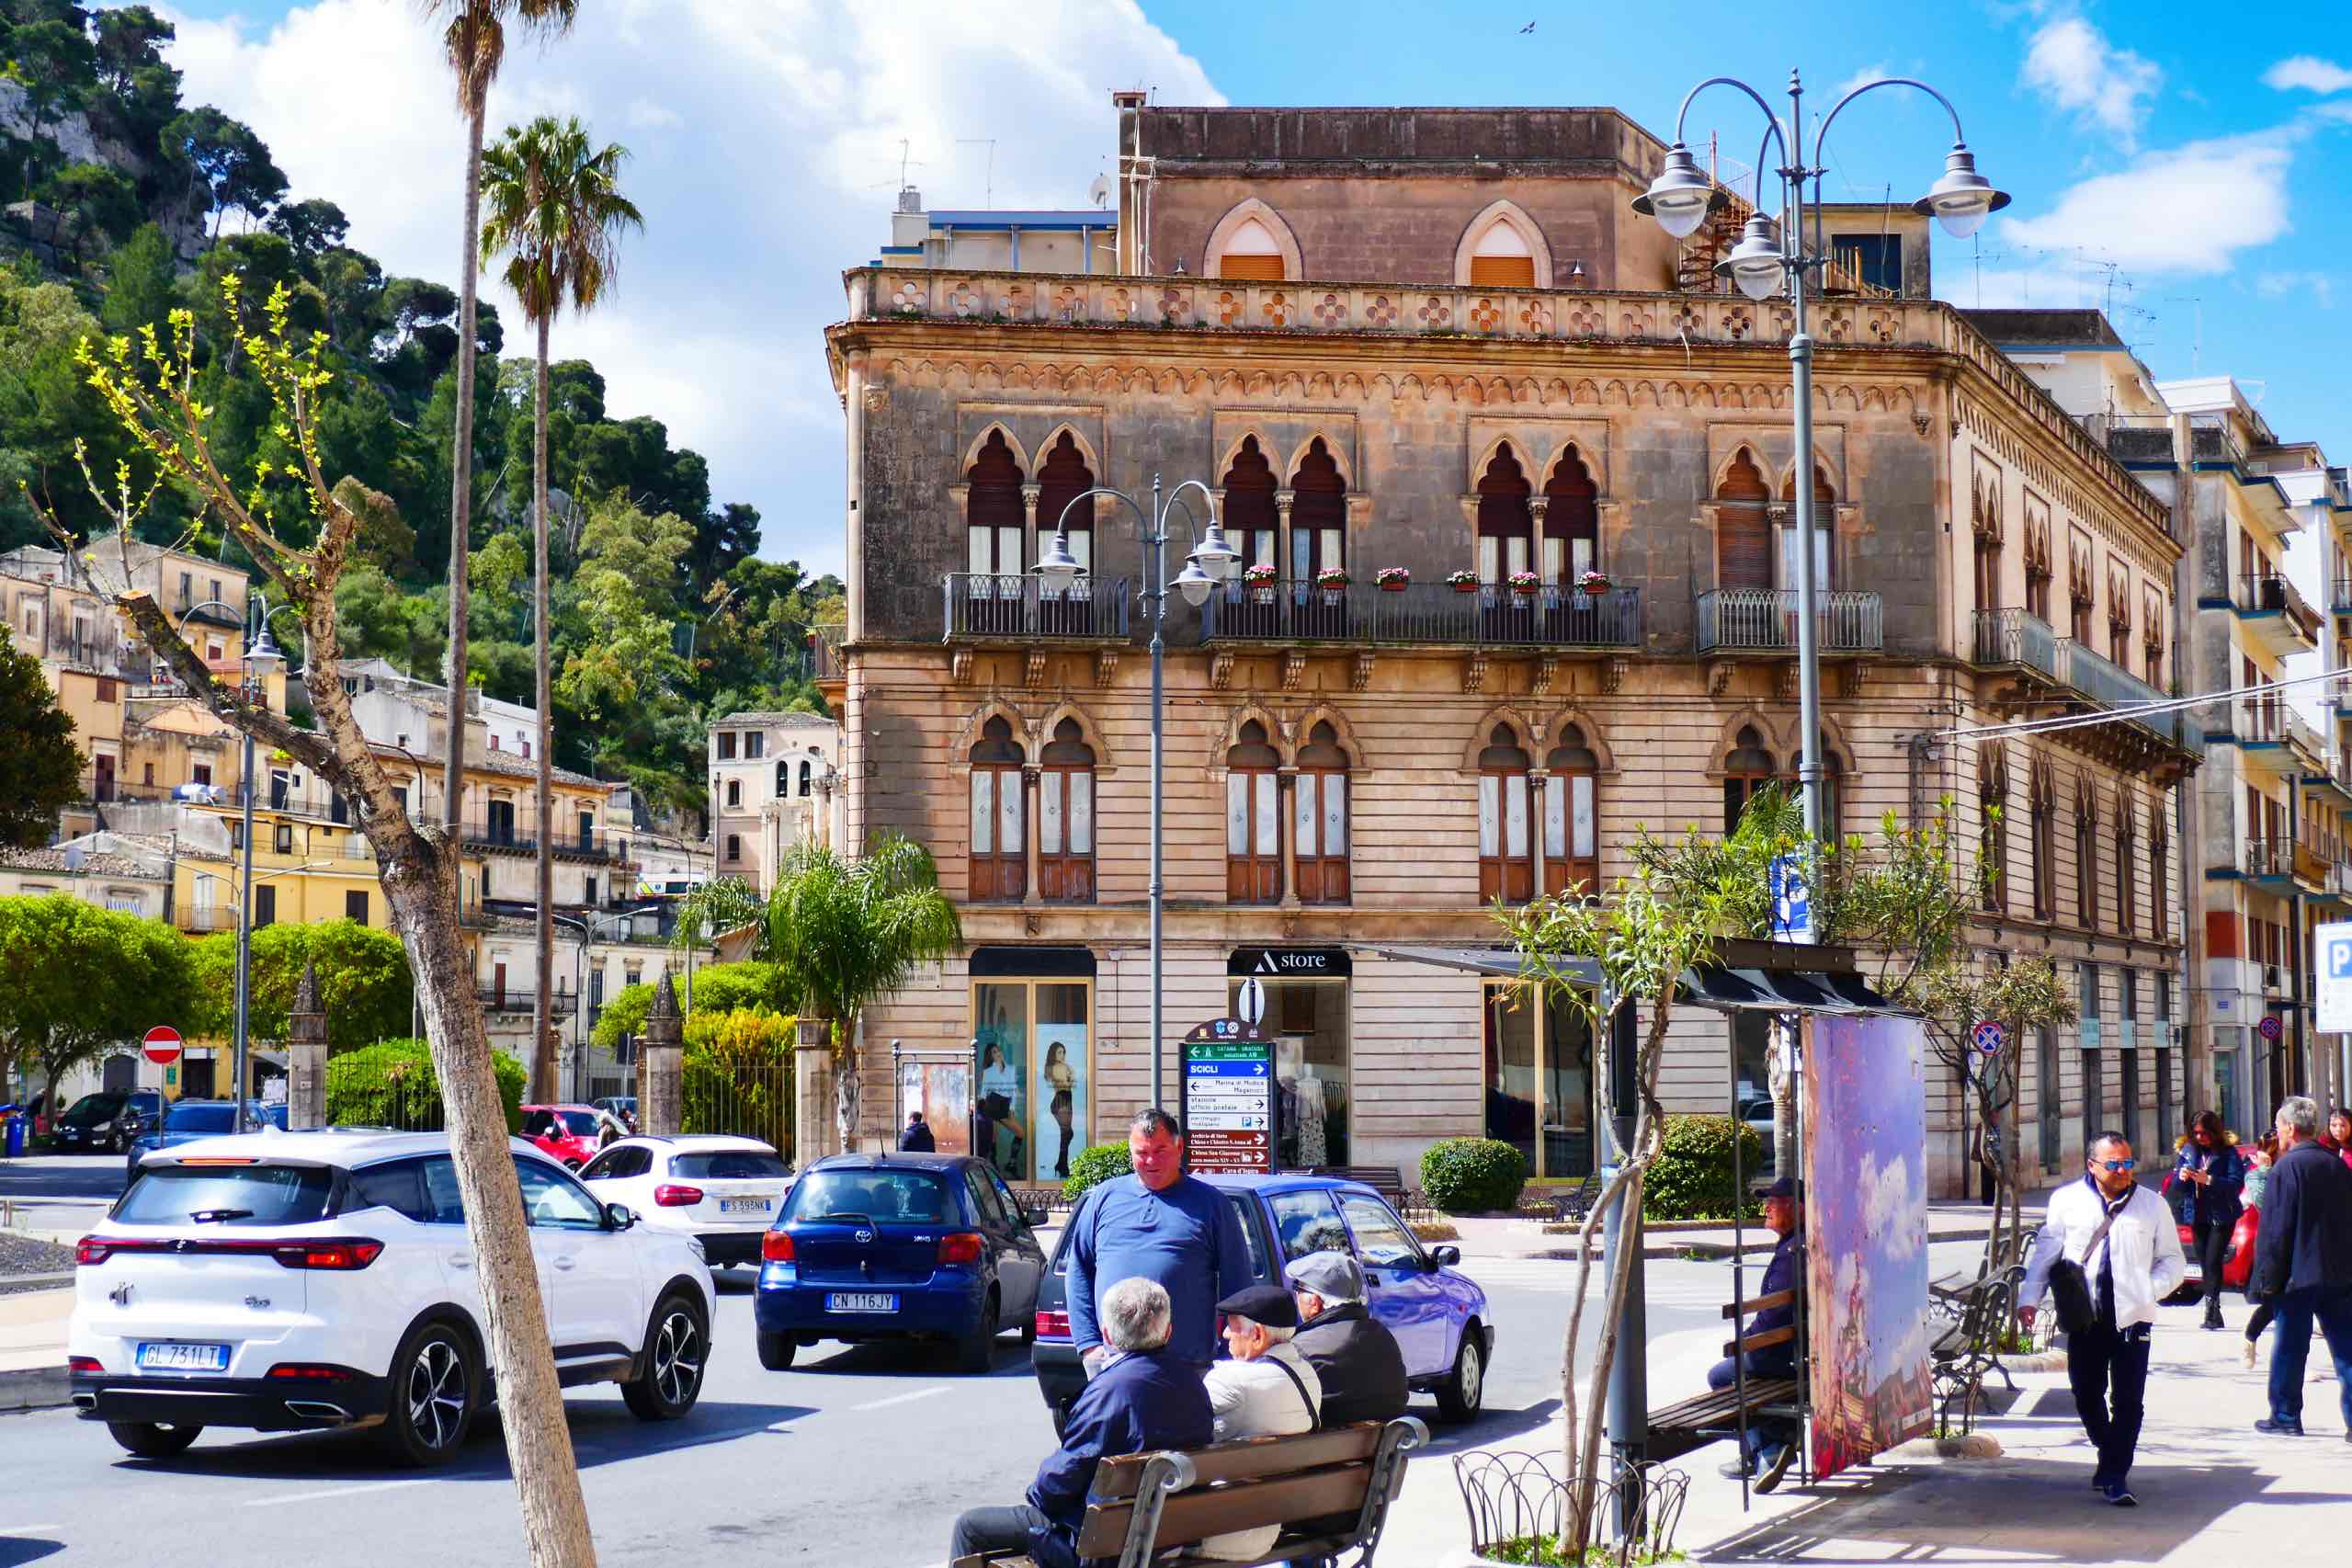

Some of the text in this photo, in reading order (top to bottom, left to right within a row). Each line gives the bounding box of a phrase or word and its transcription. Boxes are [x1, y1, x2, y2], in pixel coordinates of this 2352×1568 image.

[1280, 952, 1325, 968] store
[2332, 944, 2350, 974] P
[1190, 1065, 1219, 1074] SCICLI
[834, 1294, 892, 1309] CN 116JY
[146, 1345, 218, 1365] GL 731LT
